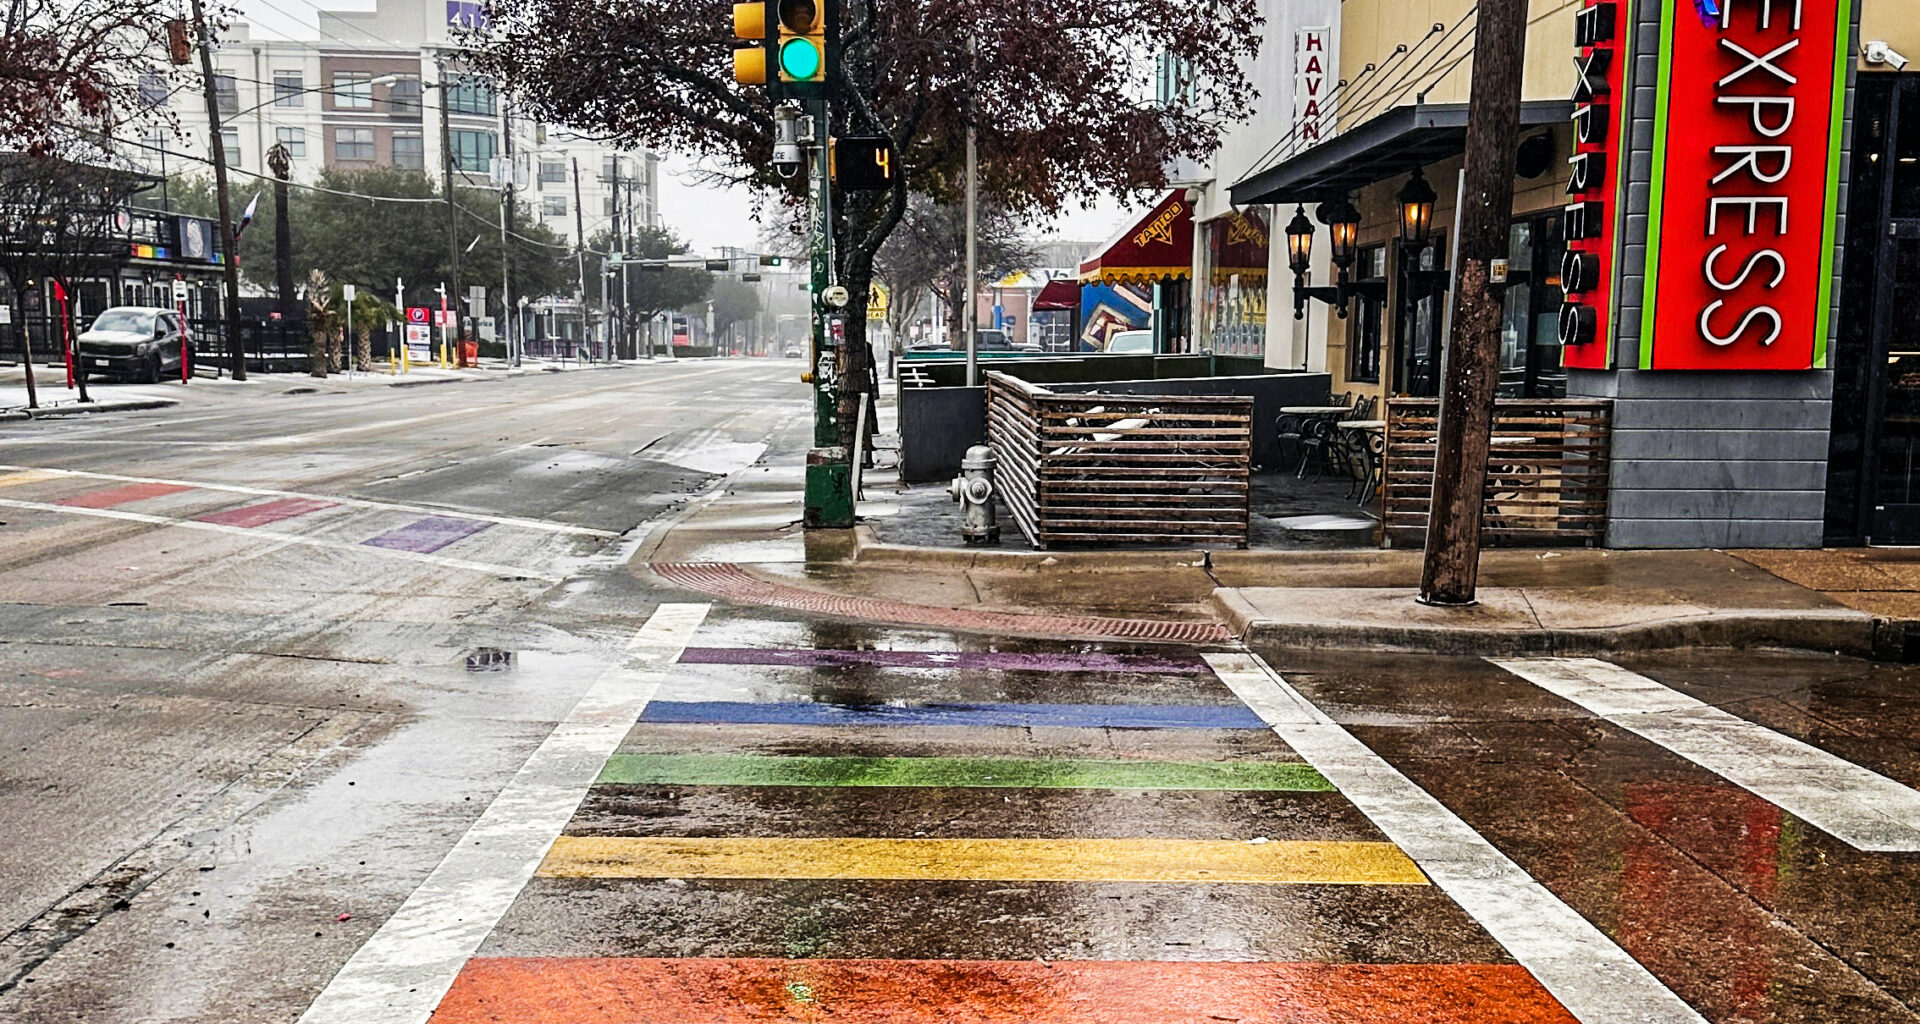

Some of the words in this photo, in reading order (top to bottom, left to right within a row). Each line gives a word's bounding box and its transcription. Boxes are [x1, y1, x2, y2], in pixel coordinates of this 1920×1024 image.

[450, 11, 488, 29] 412
[1303, 33, 1322, 140] HAVAN
[876, 148, 888, 178] 4
[1558, 3, 1606, 345] EXPRESS
[1701, 0, 1800, 346] EXPRESS
[1133, 201, 1183, 247] TATTOO
